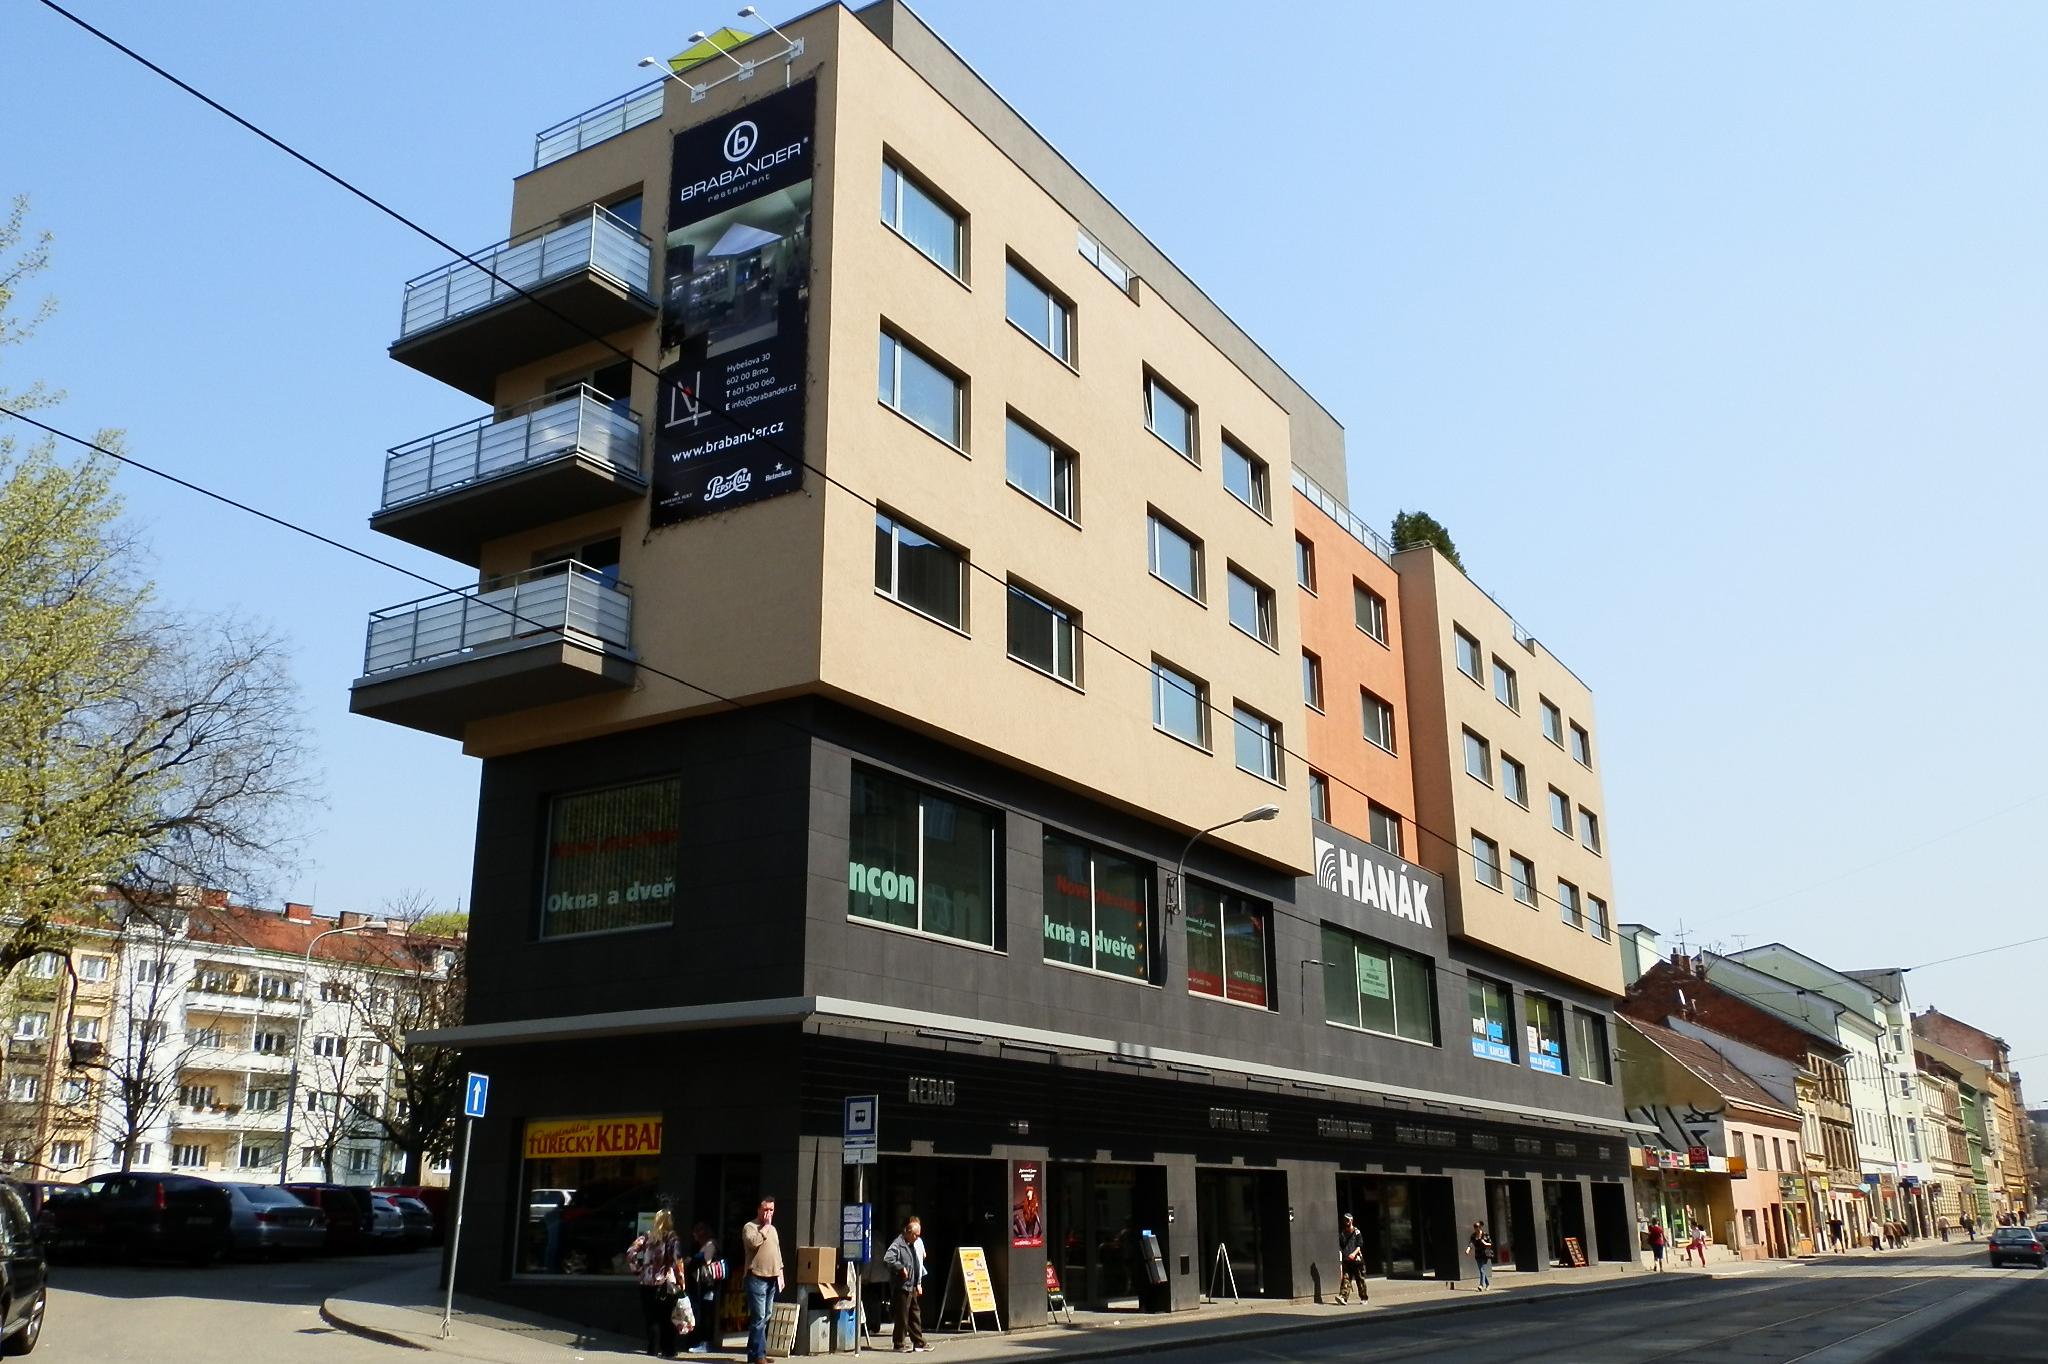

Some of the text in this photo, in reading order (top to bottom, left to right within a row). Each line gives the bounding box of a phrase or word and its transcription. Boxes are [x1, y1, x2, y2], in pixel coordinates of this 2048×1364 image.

[681, 142, 801, 202] BRABANDER
[707, 173, 771, 204] restaurant
[726, 352, 771, 373] Hybešova 30
[726, 367, 769, 386] 602 00 Brno
[725, 376, 776, 398] T 601 500 060
[725, 383, 797, 411] E info@brabander.cz
[671, 421, 784, 463] www.brabander.cz
[849, 861, 915, 905] ncon
[1339, 847, 1433, 929] HANÁK
[546, 891, 599, 913] Okna
[607, 889, 620, 905] a
[1043, 914, 1136, 960] kna a dveře
[907, 1075, 956, 1106] KEBAB
